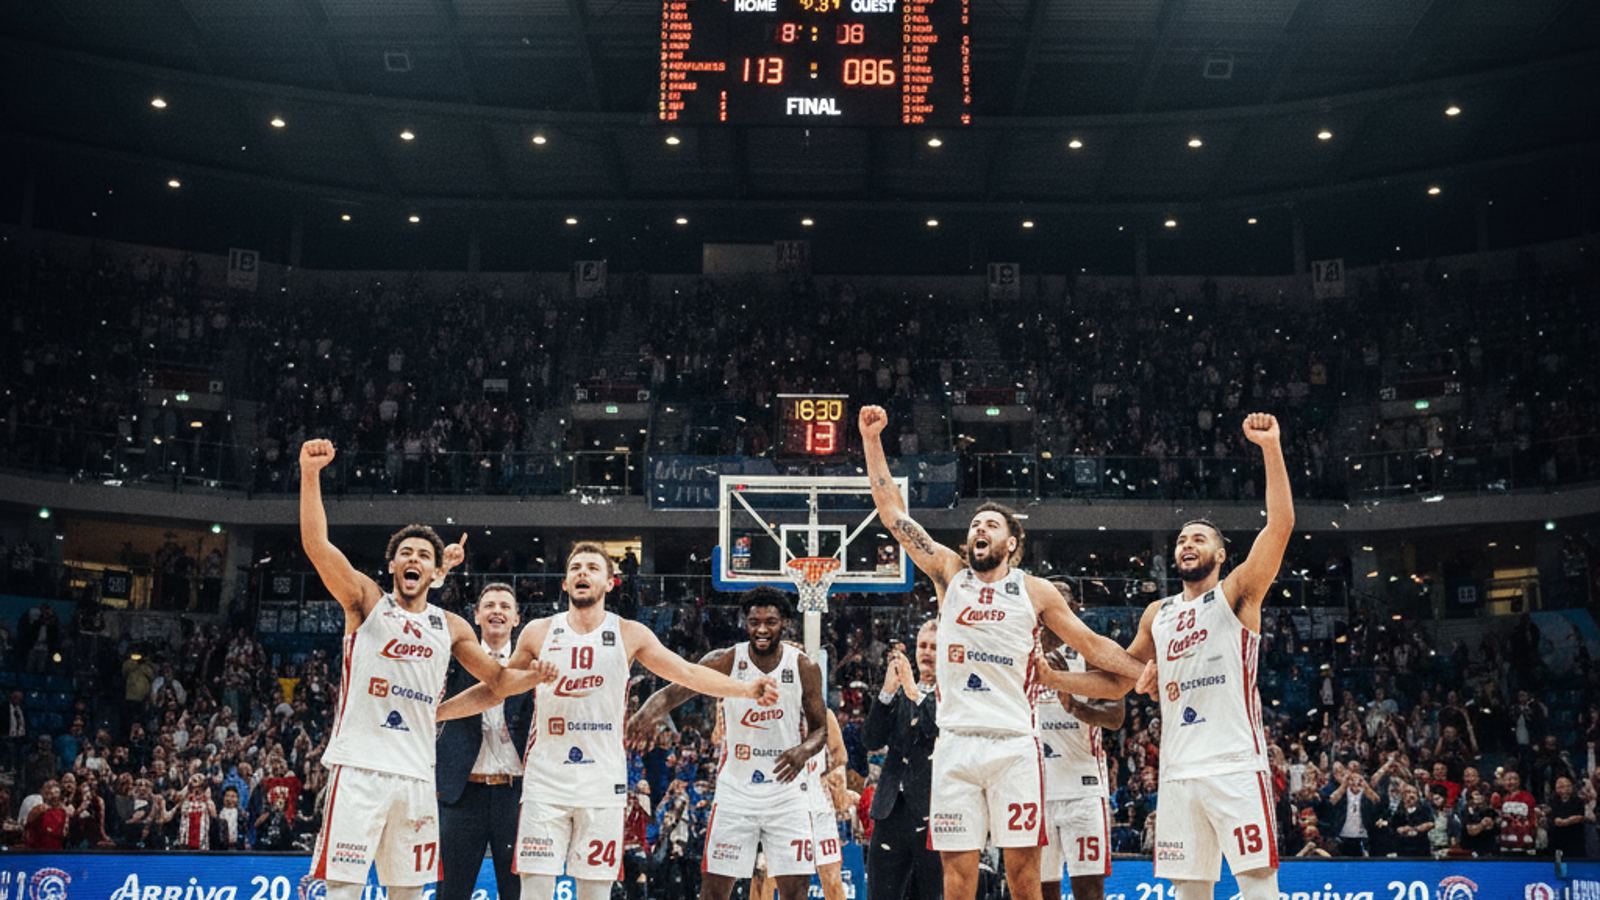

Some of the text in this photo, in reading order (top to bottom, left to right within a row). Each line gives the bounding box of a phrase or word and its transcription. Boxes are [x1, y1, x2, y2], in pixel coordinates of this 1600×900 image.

[734, 0, 777, 12] HOME
[744, 57, 784, 84] 113
[843, 58, 896, 85] 086
[786, 97, 842, 115] FINAL
[805, 421, 836, 454] 13
[1008, 802, 1038, 831] 23
[413, 842, 437, 872] 17
[587, 839, 616, 867] 24
[1076, 836, 1100, 862] 15
